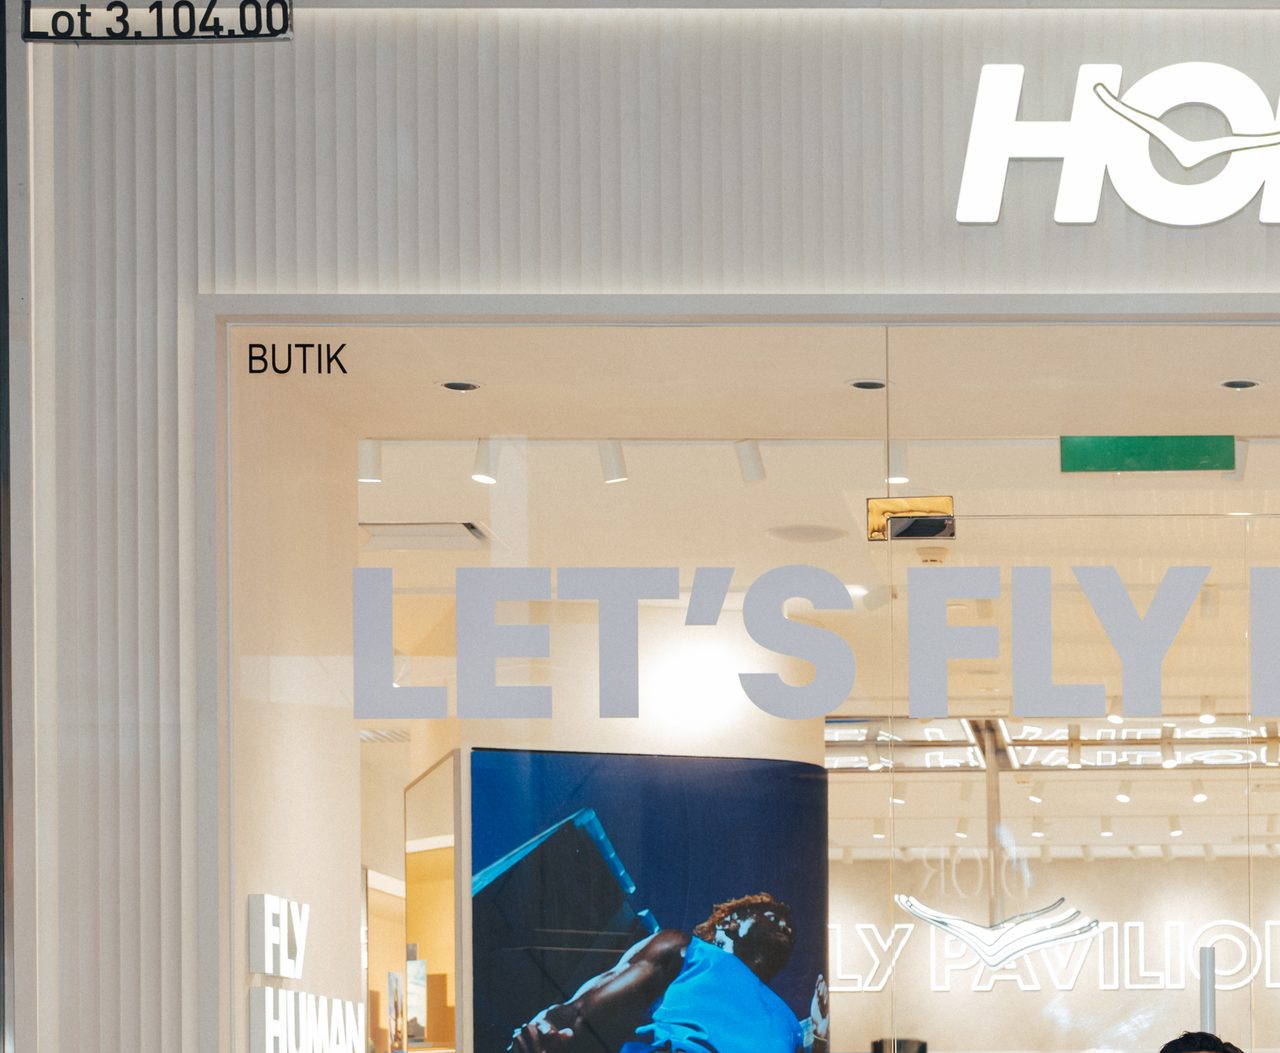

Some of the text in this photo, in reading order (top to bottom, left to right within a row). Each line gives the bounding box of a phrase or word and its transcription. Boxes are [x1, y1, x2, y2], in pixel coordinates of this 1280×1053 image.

[26, 0, 289, 37] Lot 3.104.00
[248, 343, 348, 375] BUTIK
[352, 564, 857, 720] LET'S
[907, 565, 1211, 718] FLY
[264, 893, 310, 980] FLY
[828, 924, 915, 992] LY
